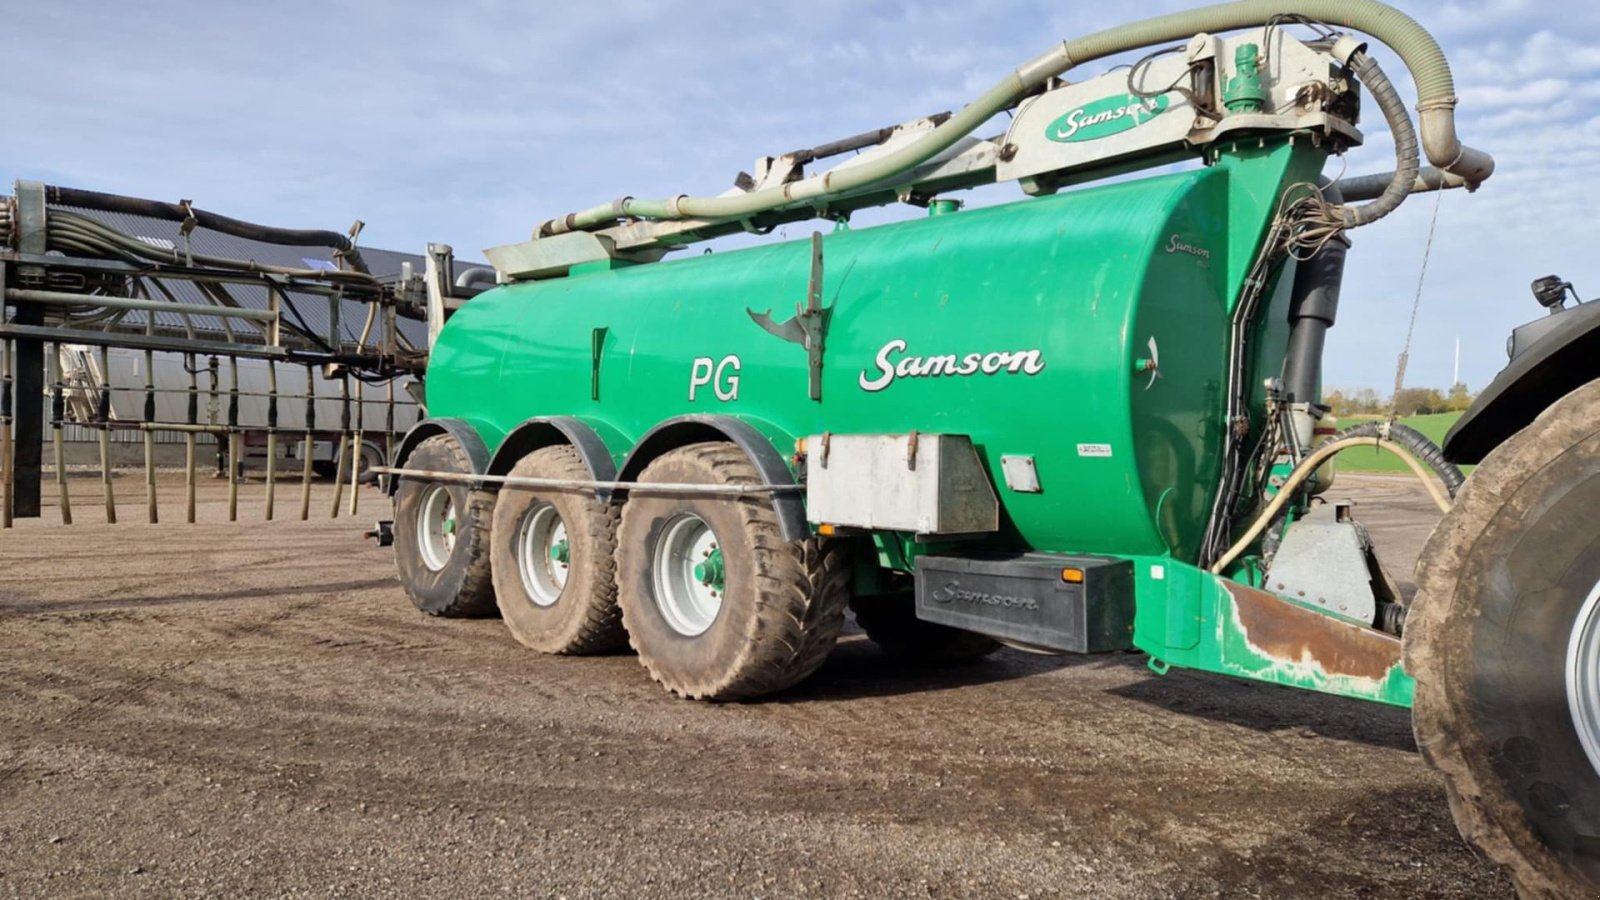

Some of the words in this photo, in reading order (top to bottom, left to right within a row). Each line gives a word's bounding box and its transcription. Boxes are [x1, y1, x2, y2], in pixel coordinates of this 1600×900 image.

[1165, 233, 1209, 258] Samson
[688, 354, 741, 402] PG
[859, 339, 1045, 392] Samson
[932, 580, 1039, 611] Samson
